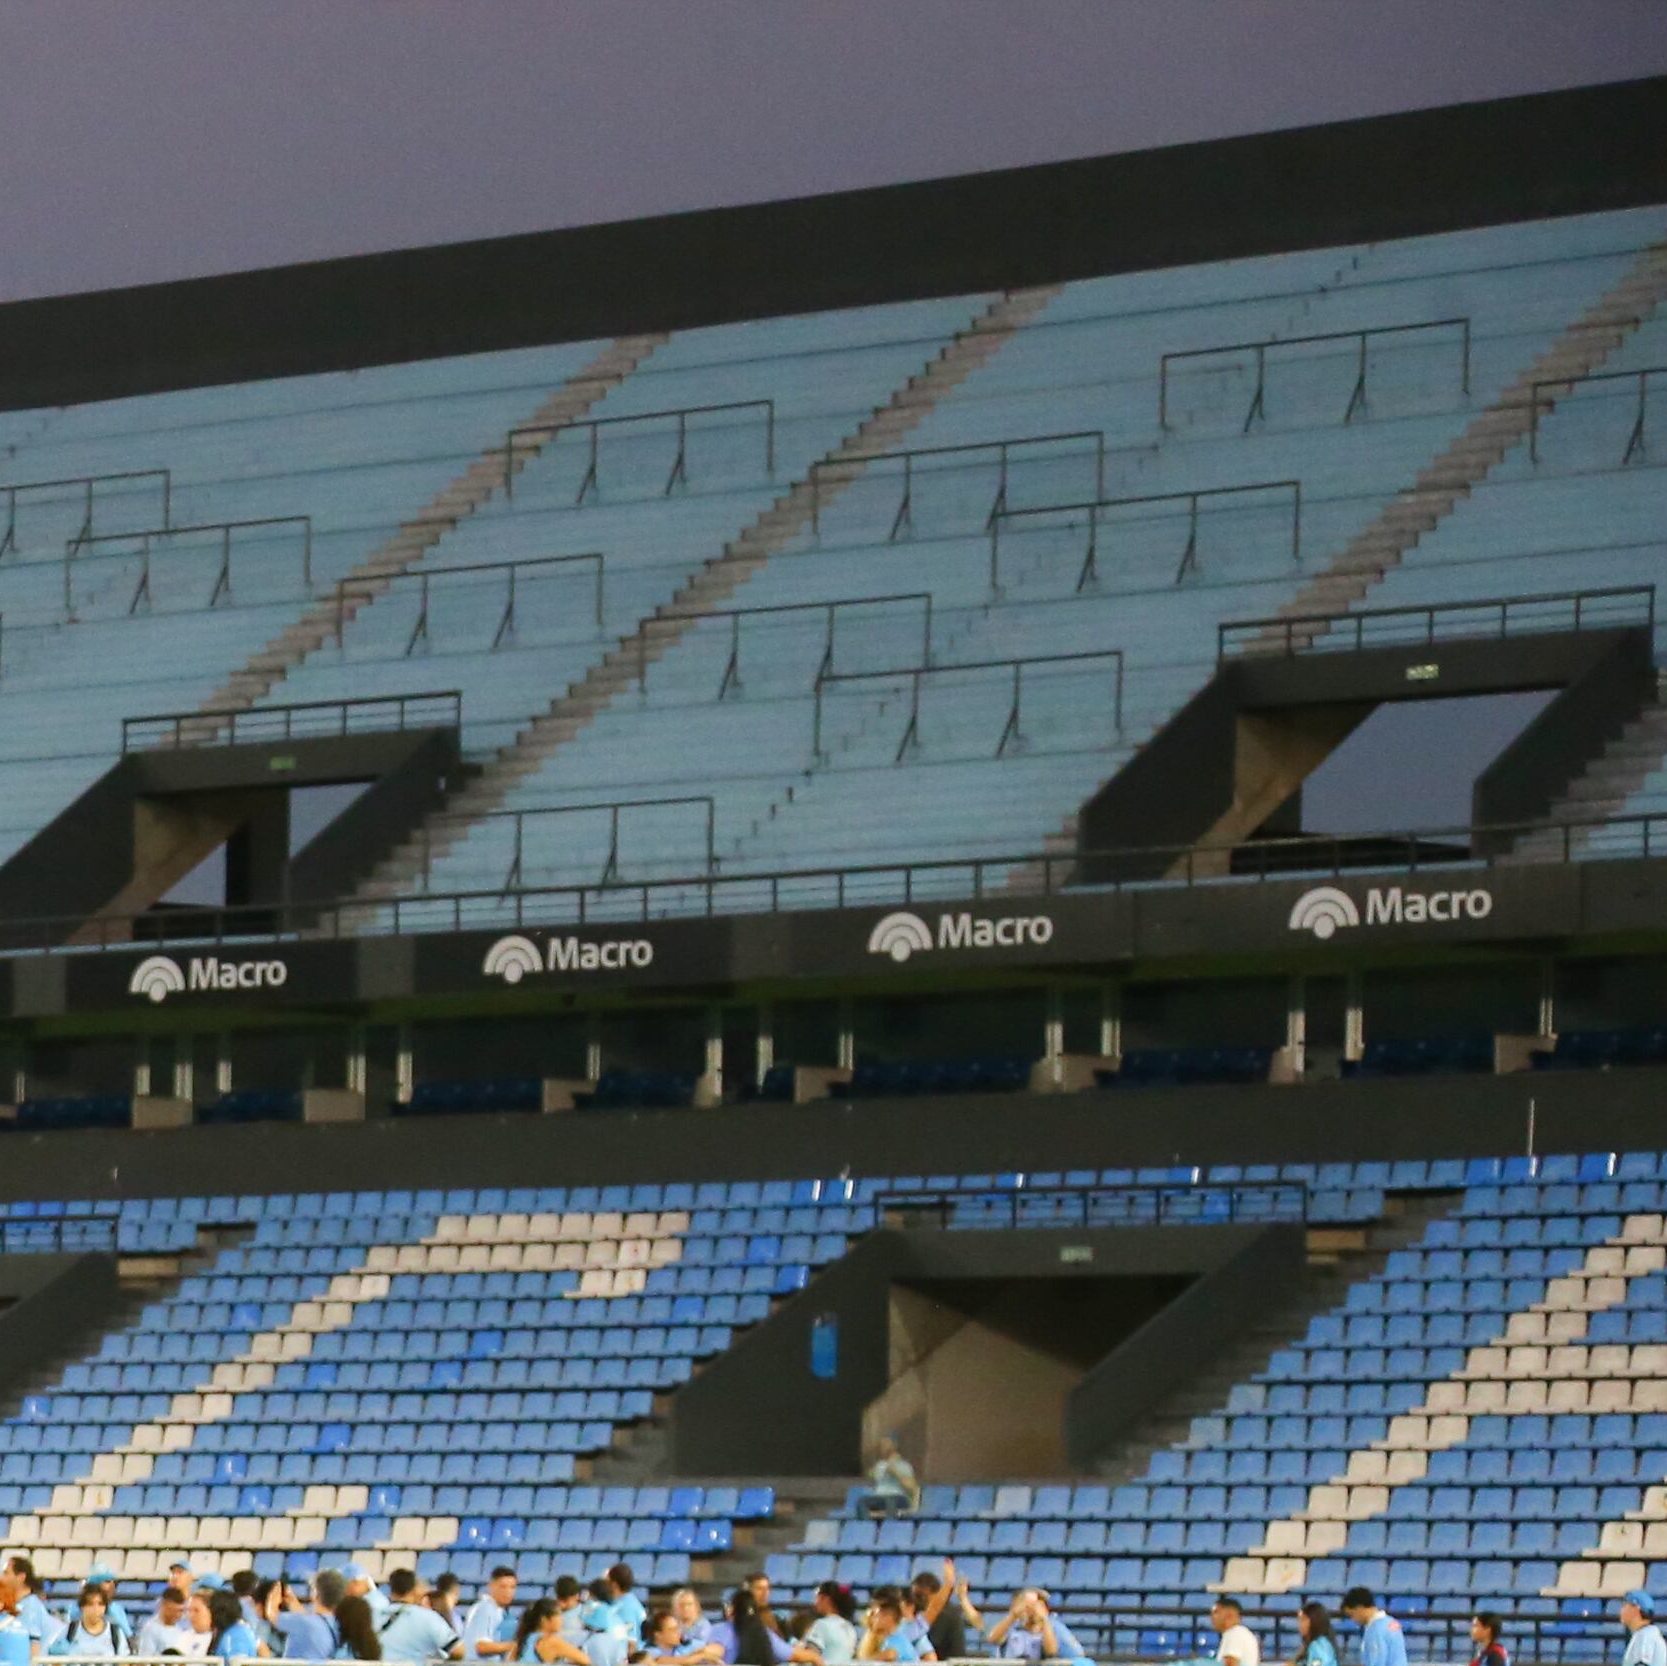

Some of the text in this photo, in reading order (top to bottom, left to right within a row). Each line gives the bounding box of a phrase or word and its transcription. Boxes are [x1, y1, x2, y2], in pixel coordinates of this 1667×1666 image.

[1366, 887, 1493, 925] Macro
[938, 912, 1055, 949] Macro
[548, 936, 654, 971] Macro
[189, 957, 288, 991] Macro
